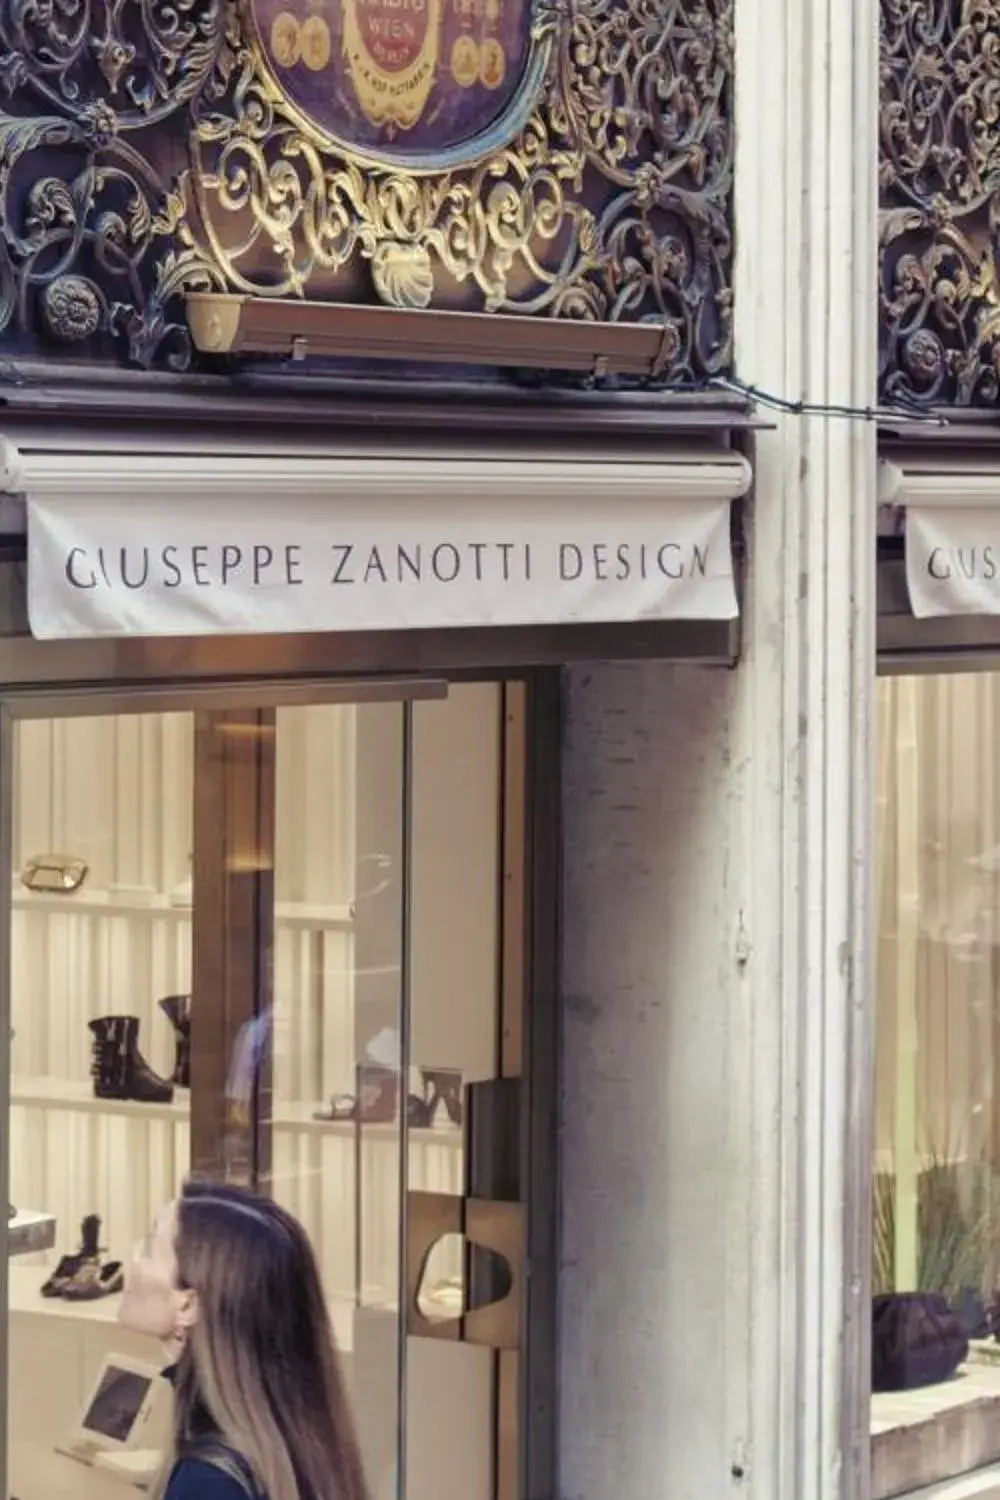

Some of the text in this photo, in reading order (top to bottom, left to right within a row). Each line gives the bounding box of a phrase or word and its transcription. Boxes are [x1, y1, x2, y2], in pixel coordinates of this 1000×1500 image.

[65, 543, 709, 590] GIUSEPPE ZANOTTI DESIGN
